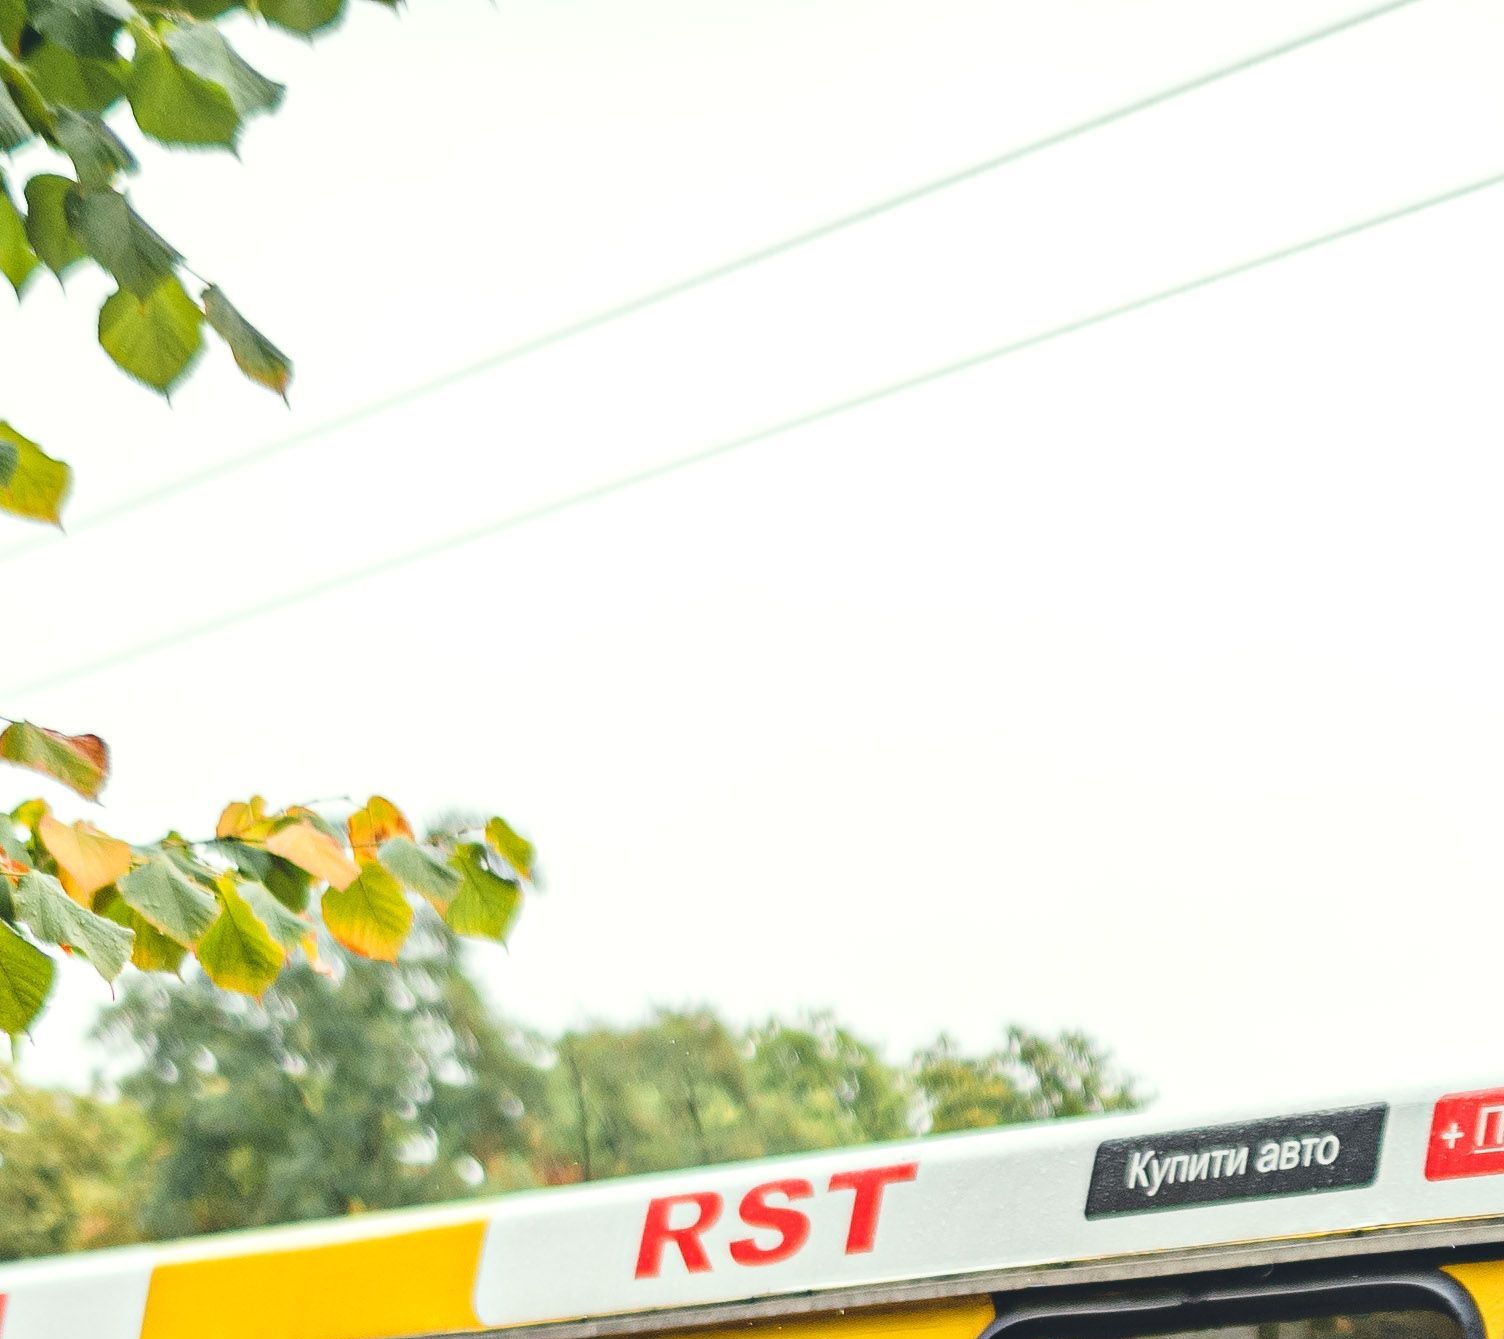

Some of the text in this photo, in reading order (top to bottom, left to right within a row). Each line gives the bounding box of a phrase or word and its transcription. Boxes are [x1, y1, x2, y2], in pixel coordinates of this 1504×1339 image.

[1127, 1128, 1341, 1198] Купити авто
[634, 1162, 919, 1279] RST
